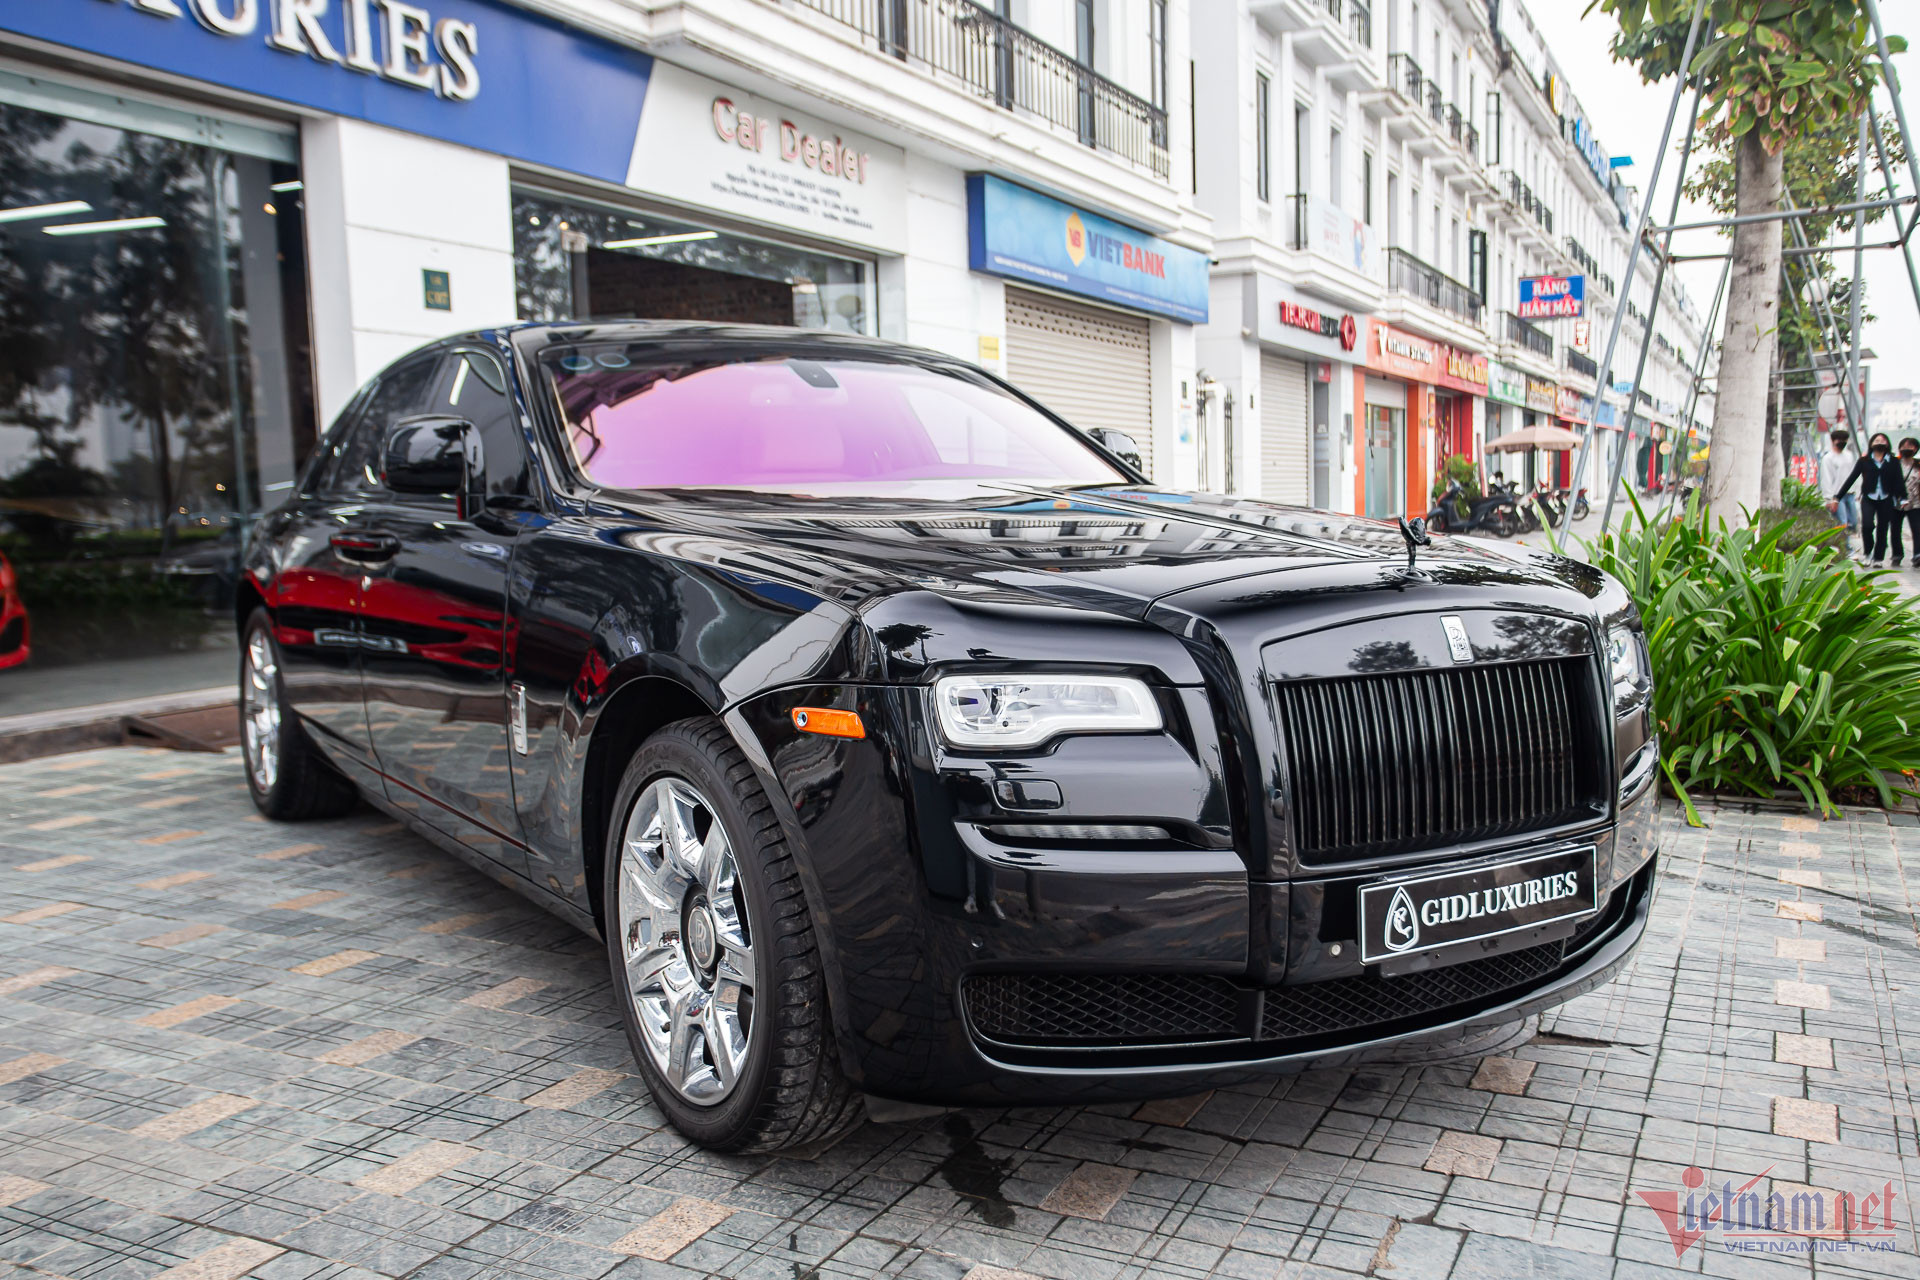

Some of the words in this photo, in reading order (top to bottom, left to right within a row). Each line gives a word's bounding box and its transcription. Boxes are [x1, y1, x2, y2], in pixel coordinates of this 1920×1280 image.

[712, 97, 769, 152] Car
[779, 118, 871, 184] Dealer
[1087, 229, 1165, 280] VIETBANK
[1421, 871, 1577, 926] GIDLUXURIES
